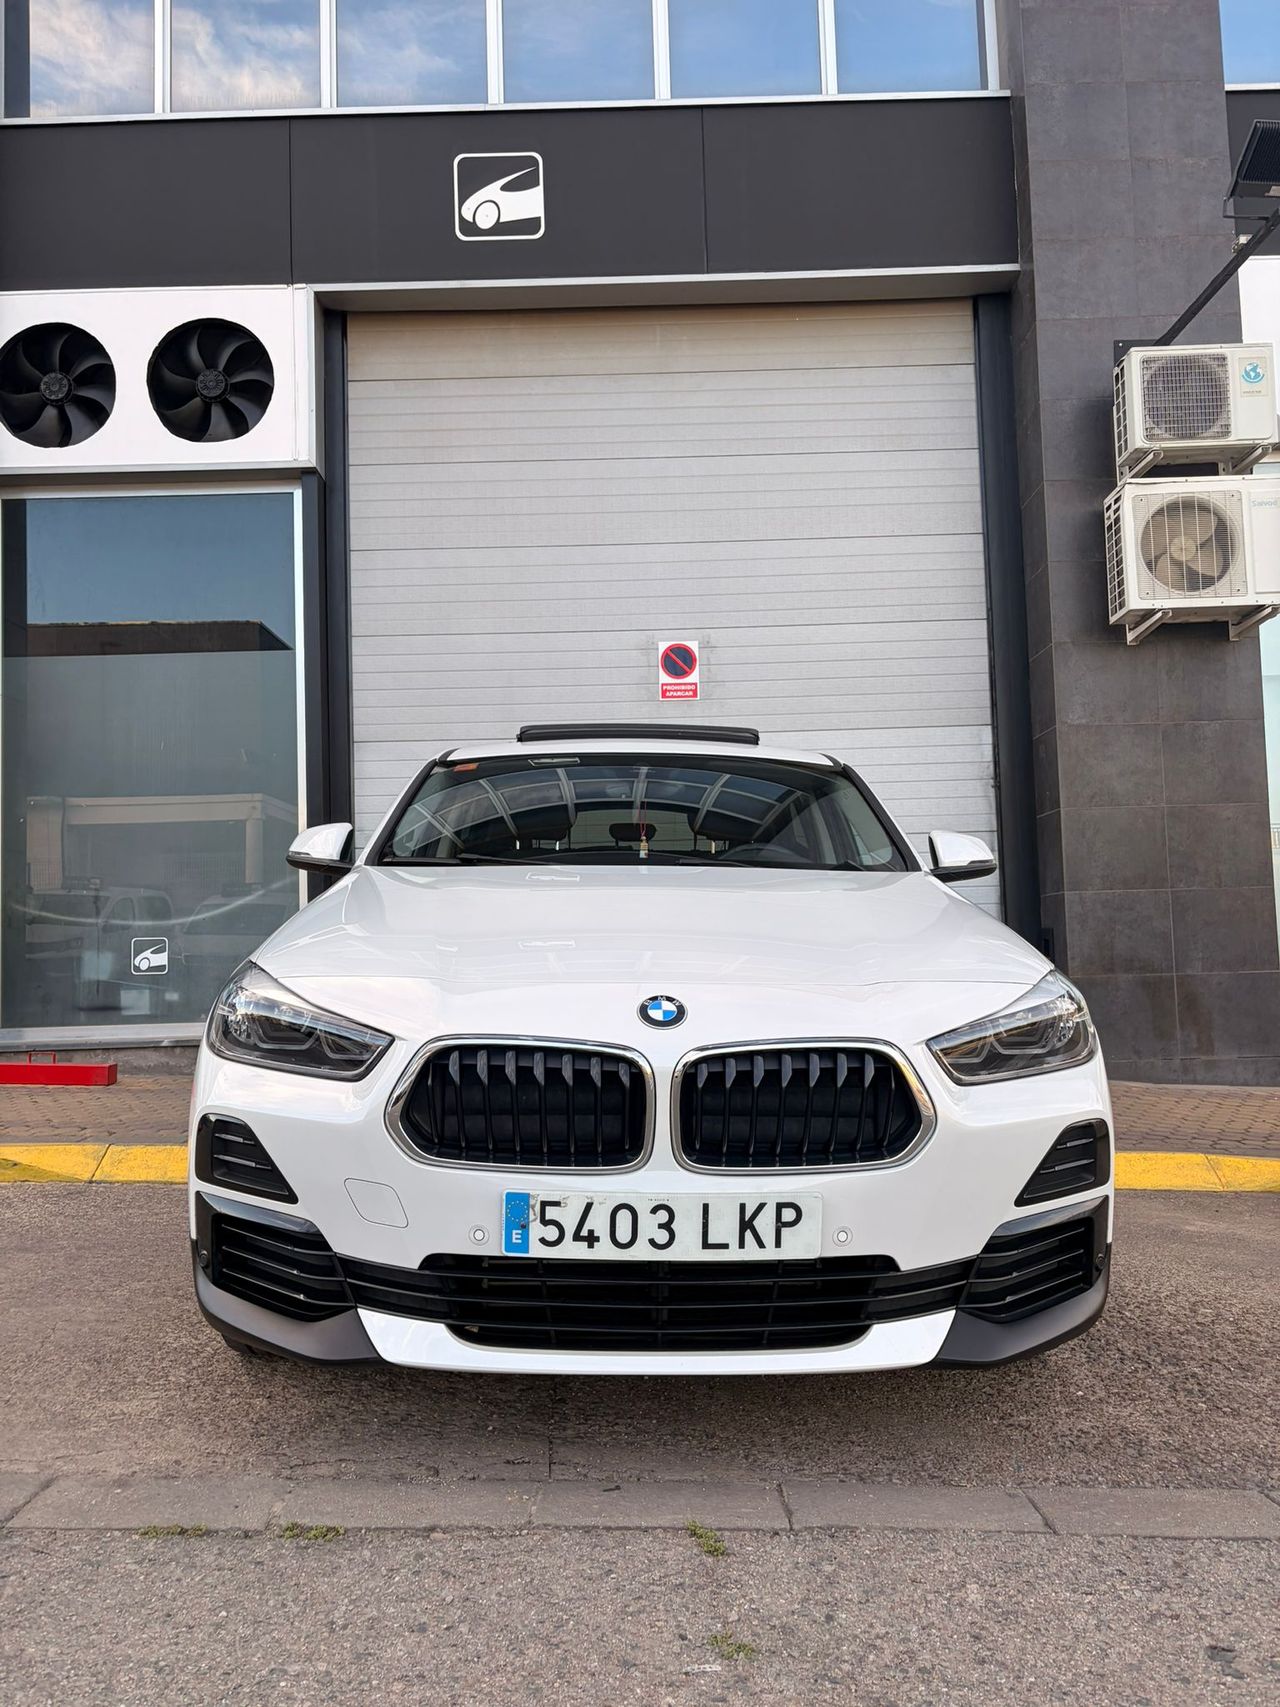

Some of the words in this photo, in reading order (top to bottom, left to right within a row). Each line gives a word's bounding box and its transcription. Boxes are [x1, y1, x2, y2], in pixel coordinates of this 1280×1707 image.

[512, 1229, 522, 1244] E
[538, 1200, 676, 1251] 5403
[702, 1202, 803, 1250] LKP
